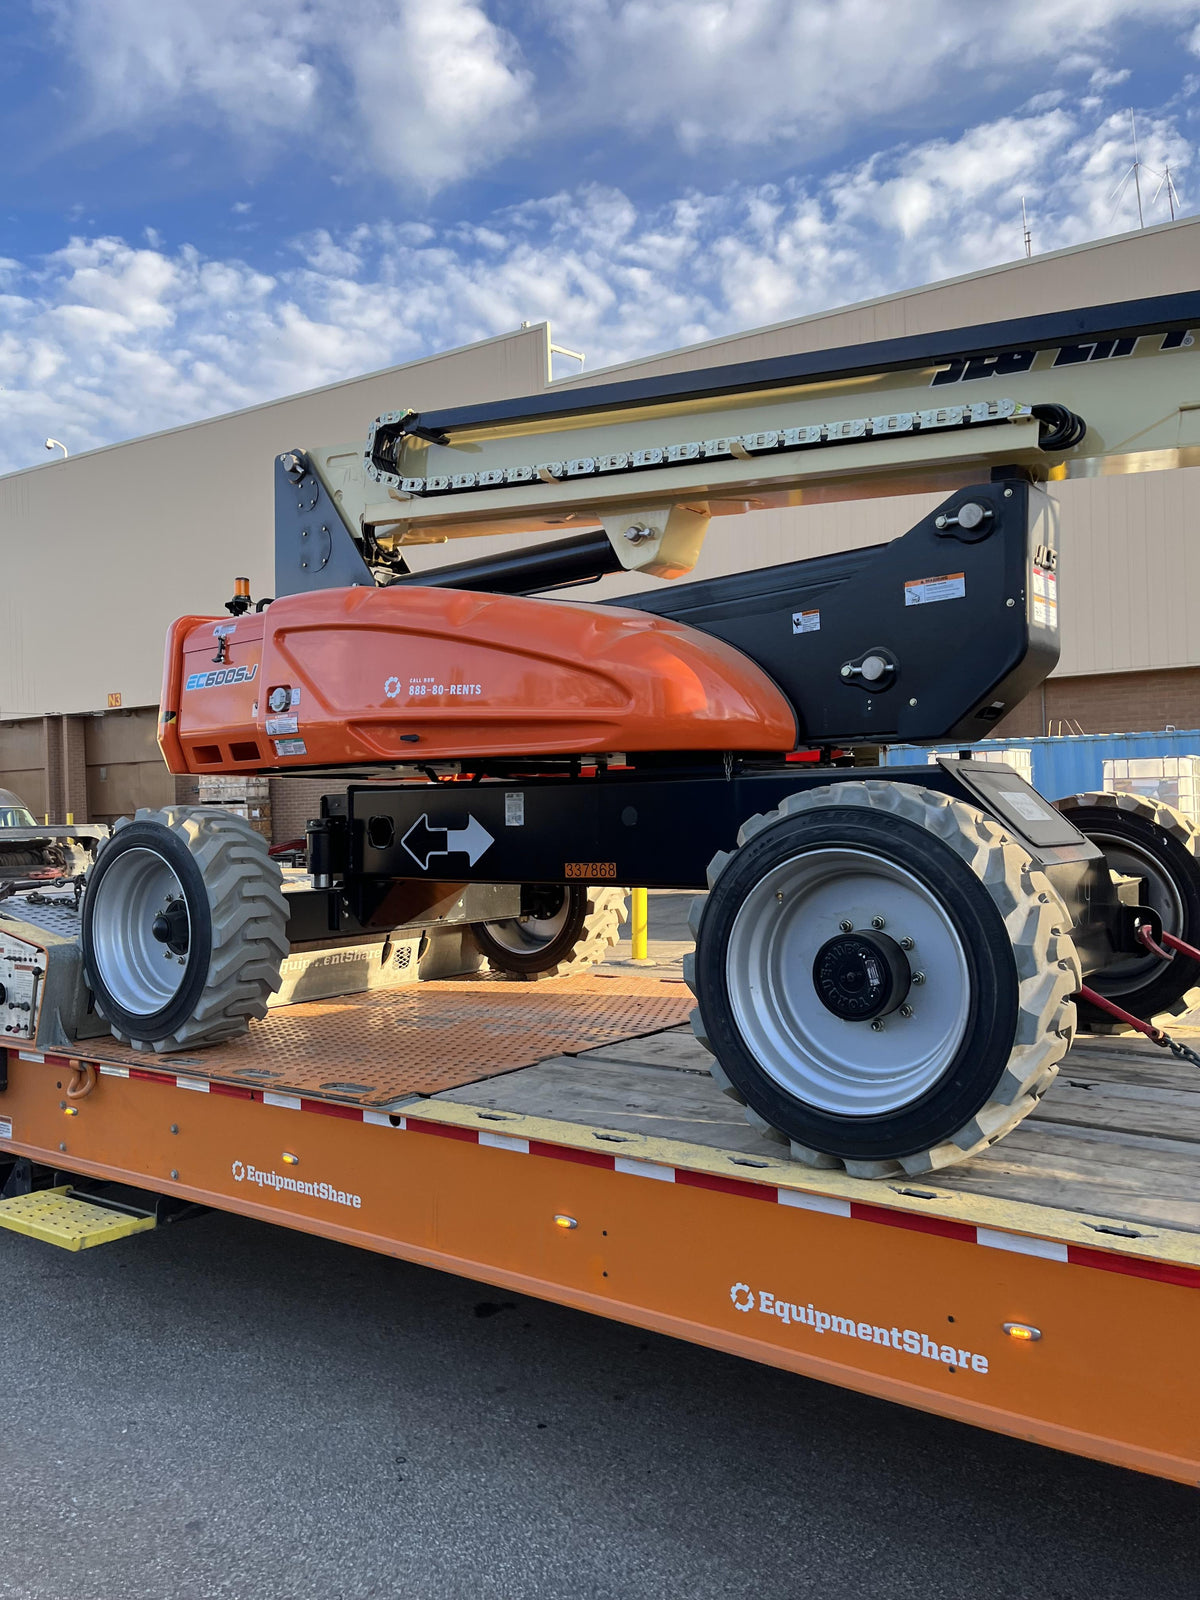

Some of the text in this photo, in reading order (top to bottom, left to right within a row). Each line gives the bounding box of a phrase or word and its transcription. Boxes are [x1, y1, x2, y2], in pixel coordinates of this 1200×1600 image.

[186, 664, 258, 691] EC600SJ
[409, 684, 482, 696] 888-80-RENTS
[108, 693, 121, 707] N3
[566, 863, 616, 877] 337868
[280, 948, 381, 975] quipentShare
[247, 1165, 361, 1209] EquipmentShare
[759, 1290, 989, 1374] EquipmentShare
